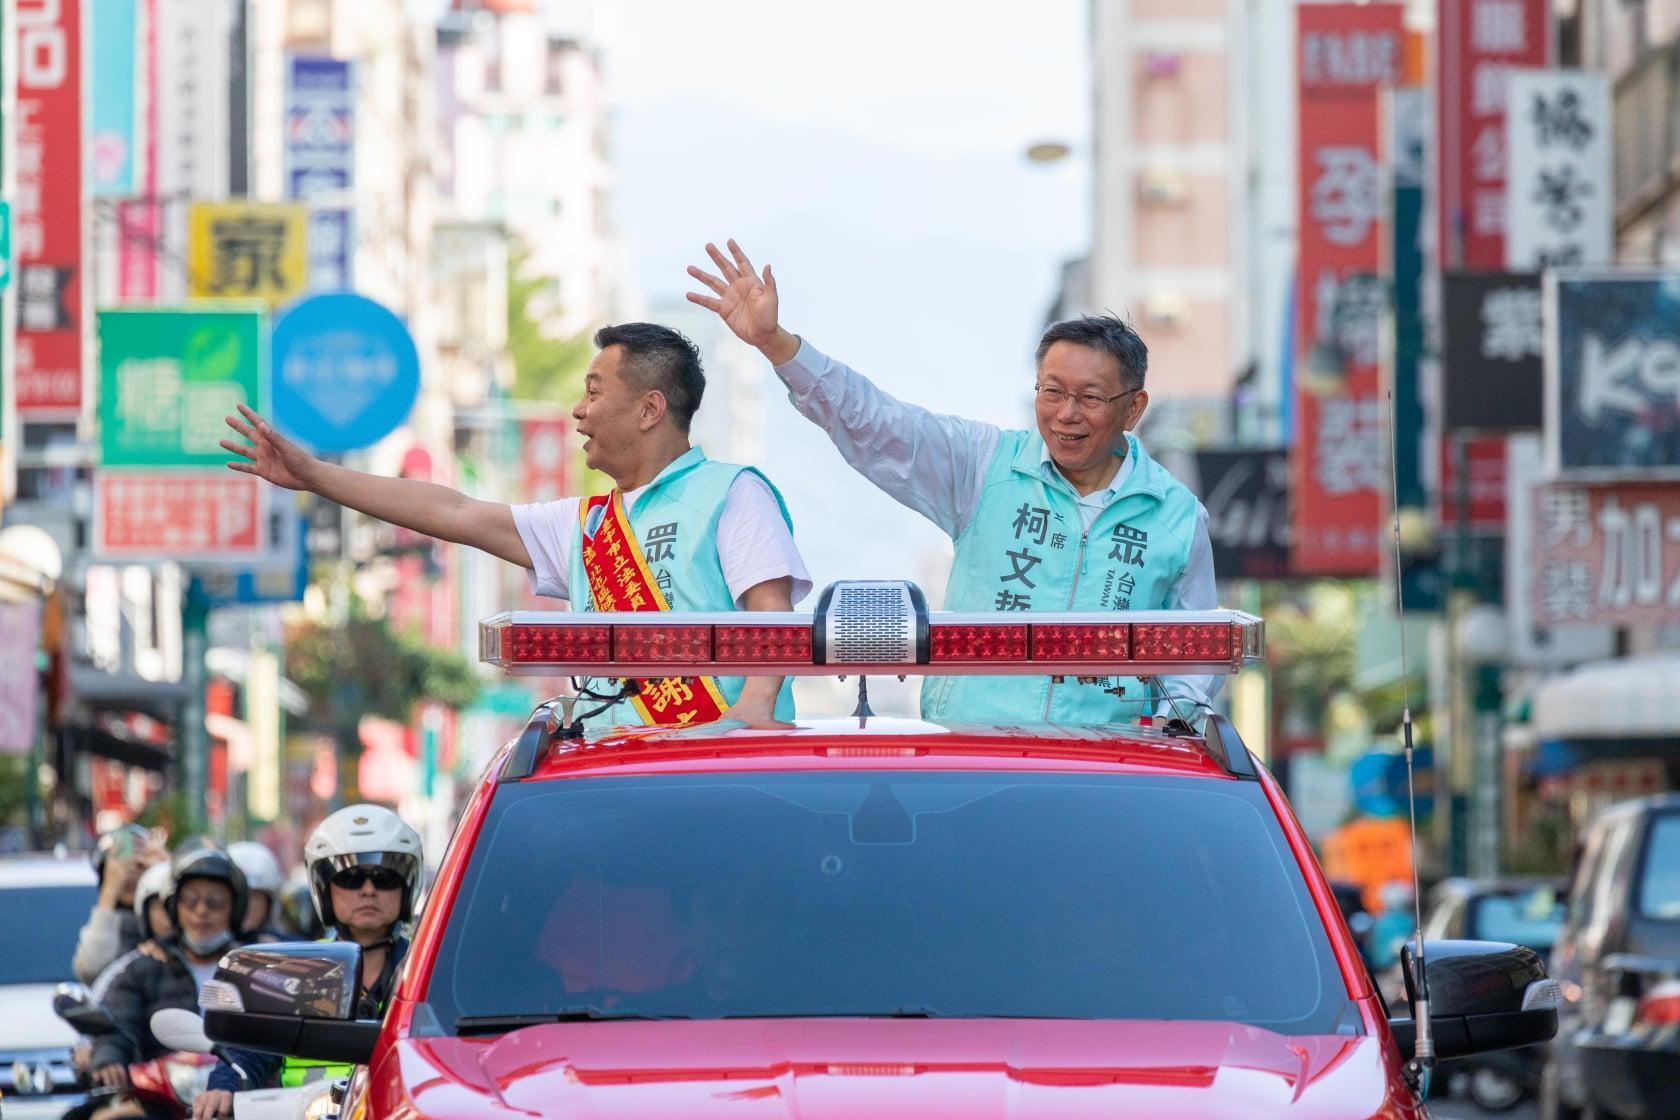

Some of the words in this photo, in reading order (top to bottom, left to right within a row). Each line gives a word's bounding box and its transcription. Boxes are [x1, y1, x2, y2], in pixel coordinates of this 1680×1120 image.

[644, 522, 678, 564] 眾
[1108, 522, 1149, 569] 眾
[1100, 568, 1116, 608] TAIWAN
